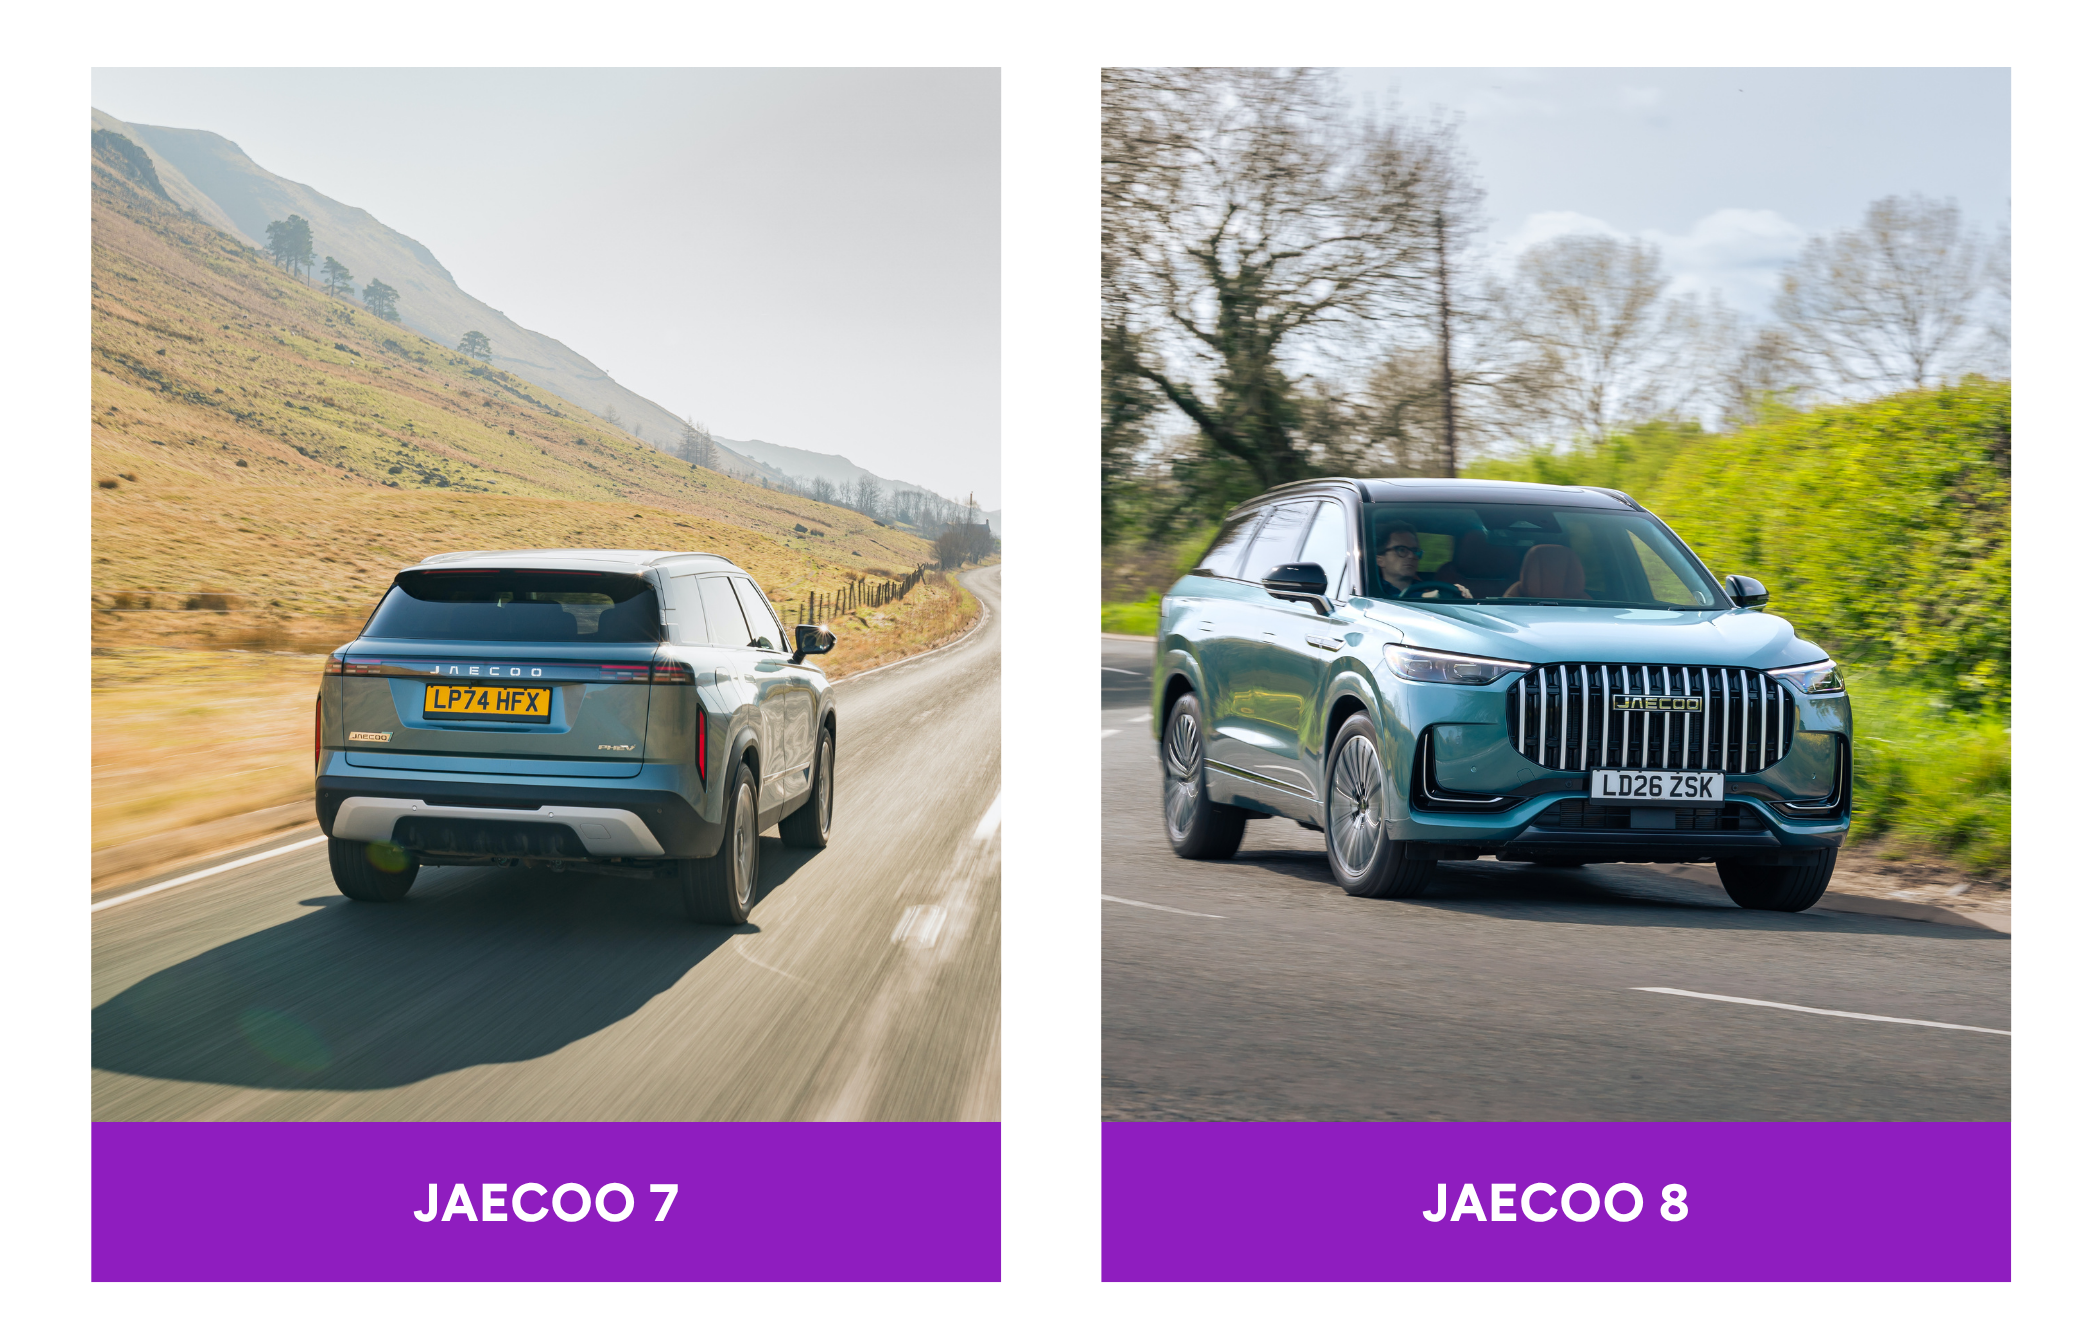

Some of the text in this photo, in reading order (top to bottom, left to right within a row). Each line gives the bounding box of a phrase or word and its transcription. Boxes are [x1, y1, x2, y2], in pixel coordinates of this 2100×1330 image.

[430, 665, 542, 677] JAECOO
[433, 689, 540, 712] LP74 HFX
[1615, 697, 1699, 710] JAECOO
[1603, 774, 1713, 798] LD26 ZSK
